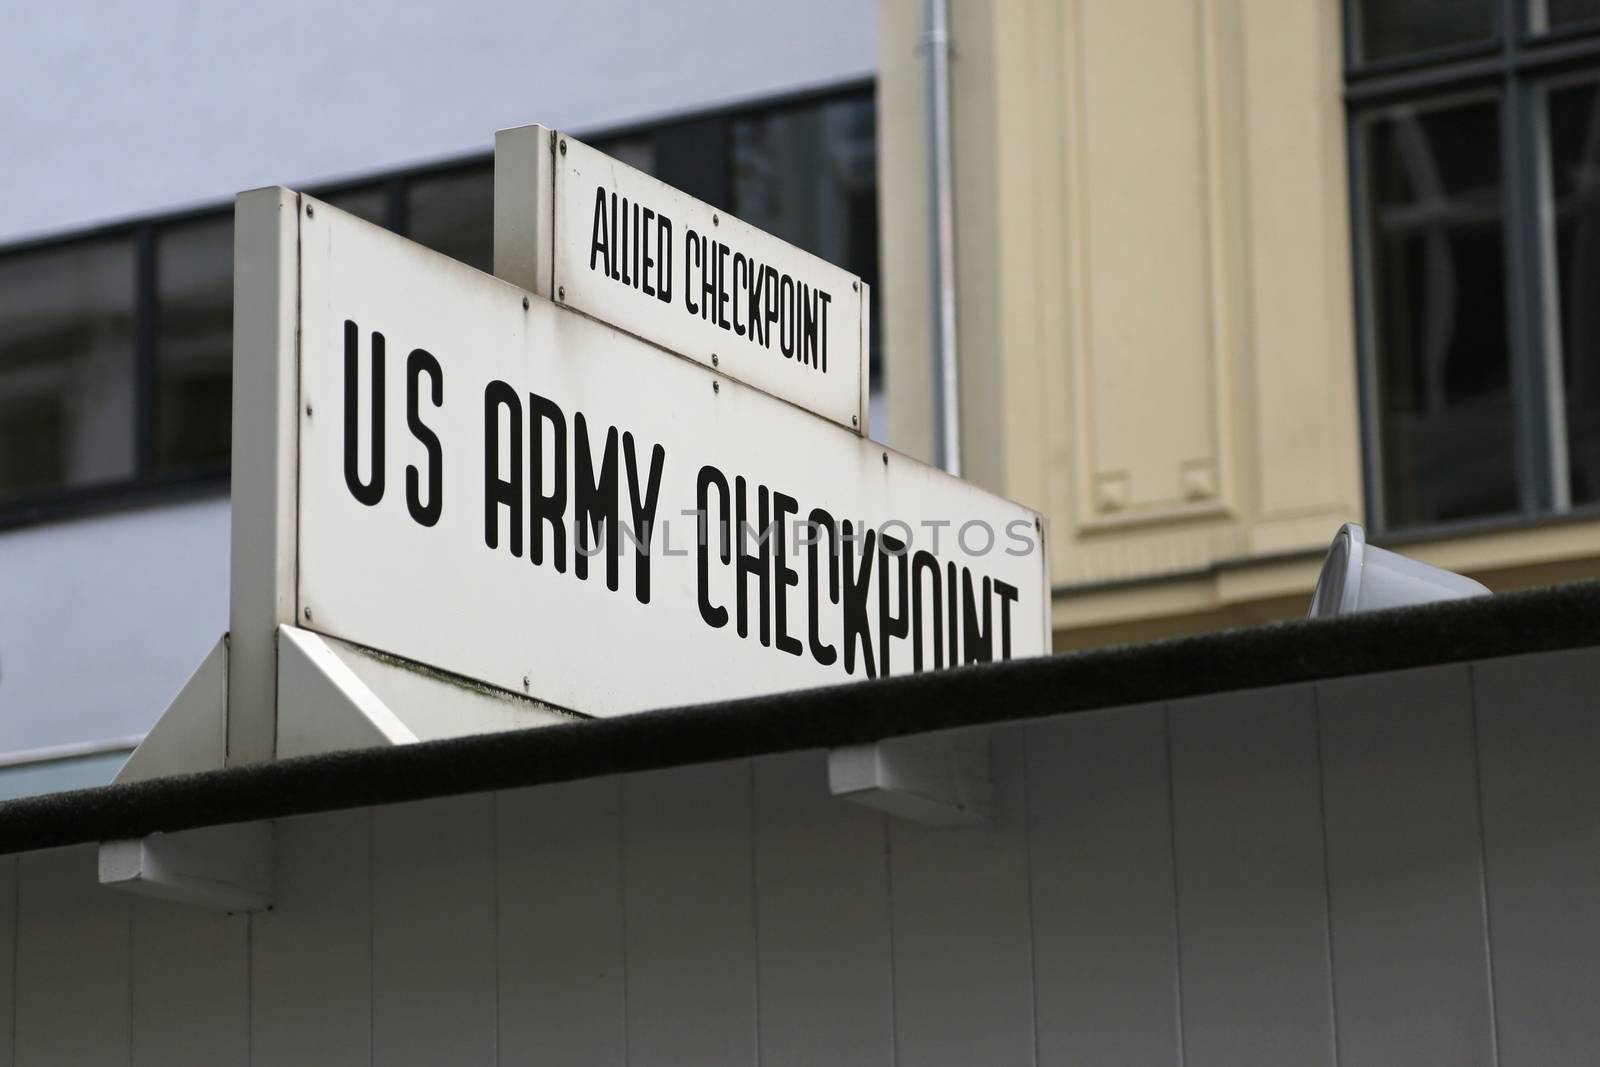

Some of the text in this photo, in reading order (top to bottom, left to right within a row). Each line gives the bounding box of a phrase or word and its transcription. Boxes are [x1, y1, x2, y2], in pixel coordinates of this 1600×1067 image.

[590, 186, 832, 373] ALLIED CHECKPOINT
[343, 319, 1019, 680] US ARMY CHECKPOINT
